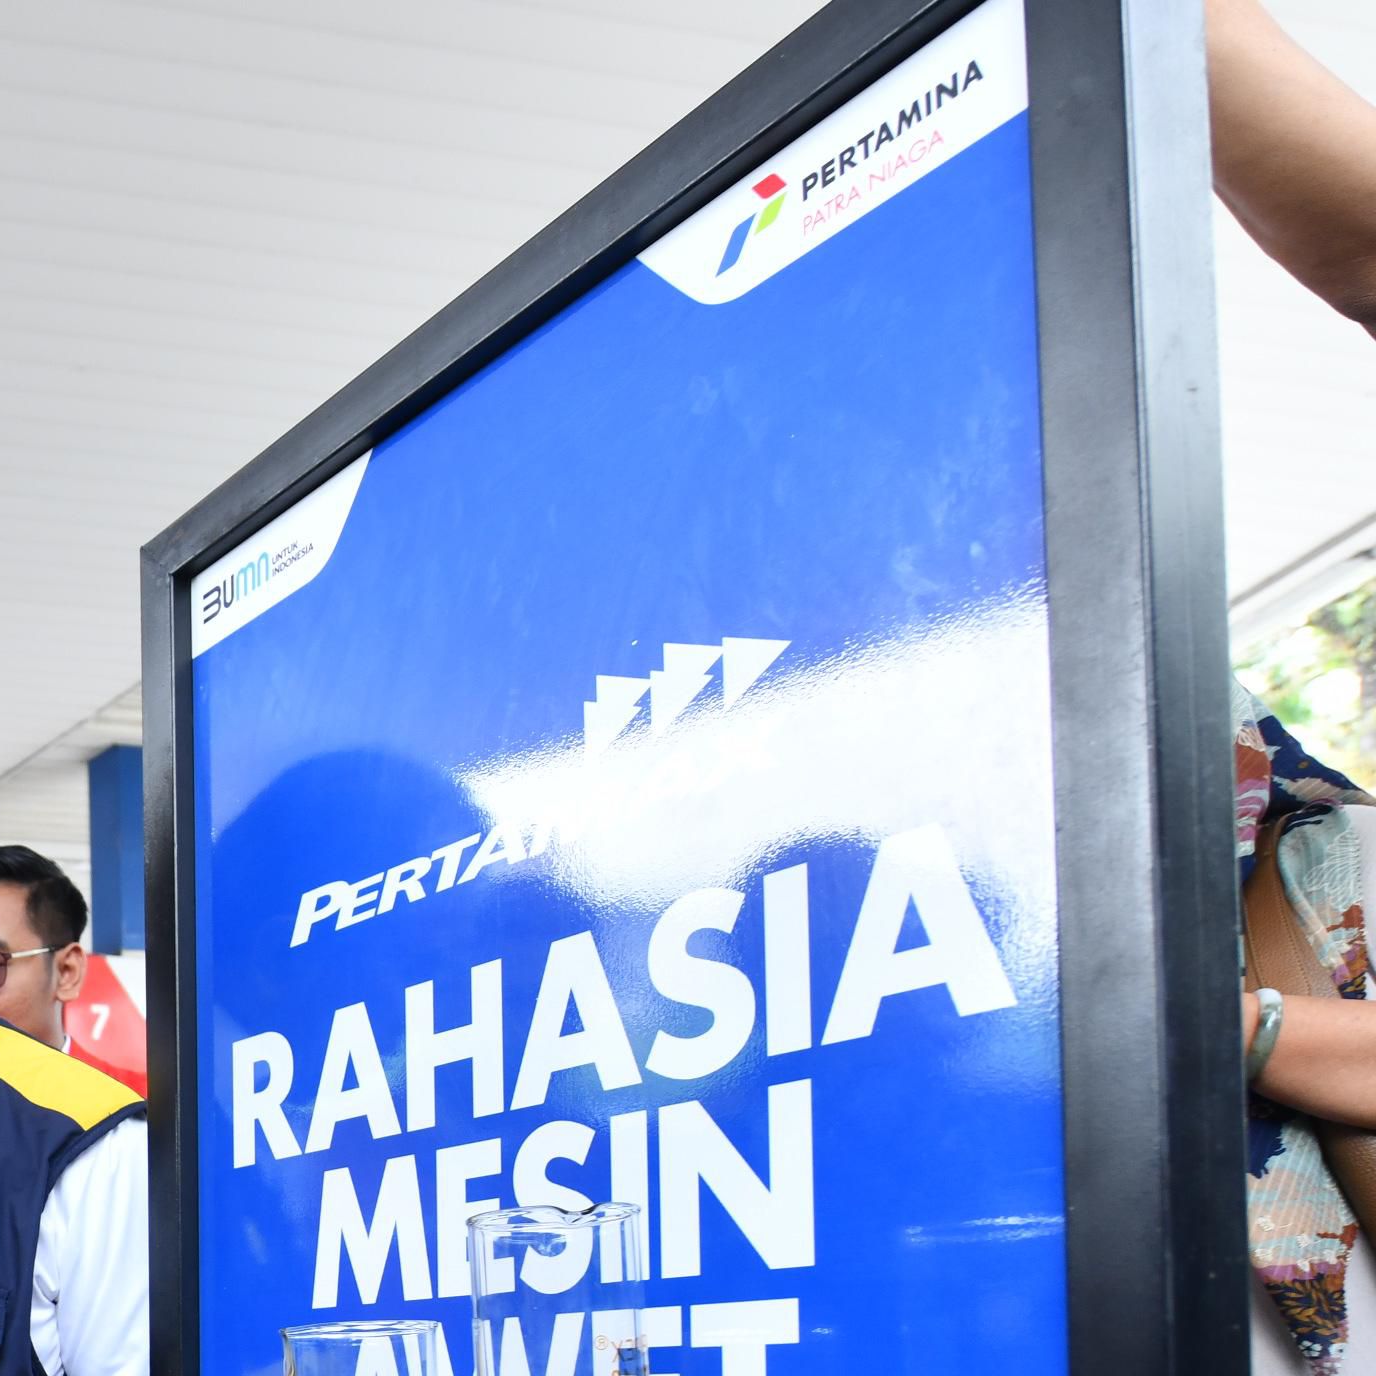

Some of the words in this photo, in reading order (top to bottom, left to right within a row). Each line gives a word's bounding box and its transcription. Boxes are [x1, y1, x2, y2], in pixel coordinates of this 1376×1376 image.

[802, 60, 983, 202] PERTAMINA
[803, 186, 861, 236] PATRA
[869, 130, 944, 191] NIAGA
[272, 540, 298, 565] UNTUK
[272, 543, 314, 577] INDONESIA
[90, 1004, 110, 1040] 7
[232, 823, 1018, 1169] RAHASIA
[312, 1079, 815, 1308] MESIN
